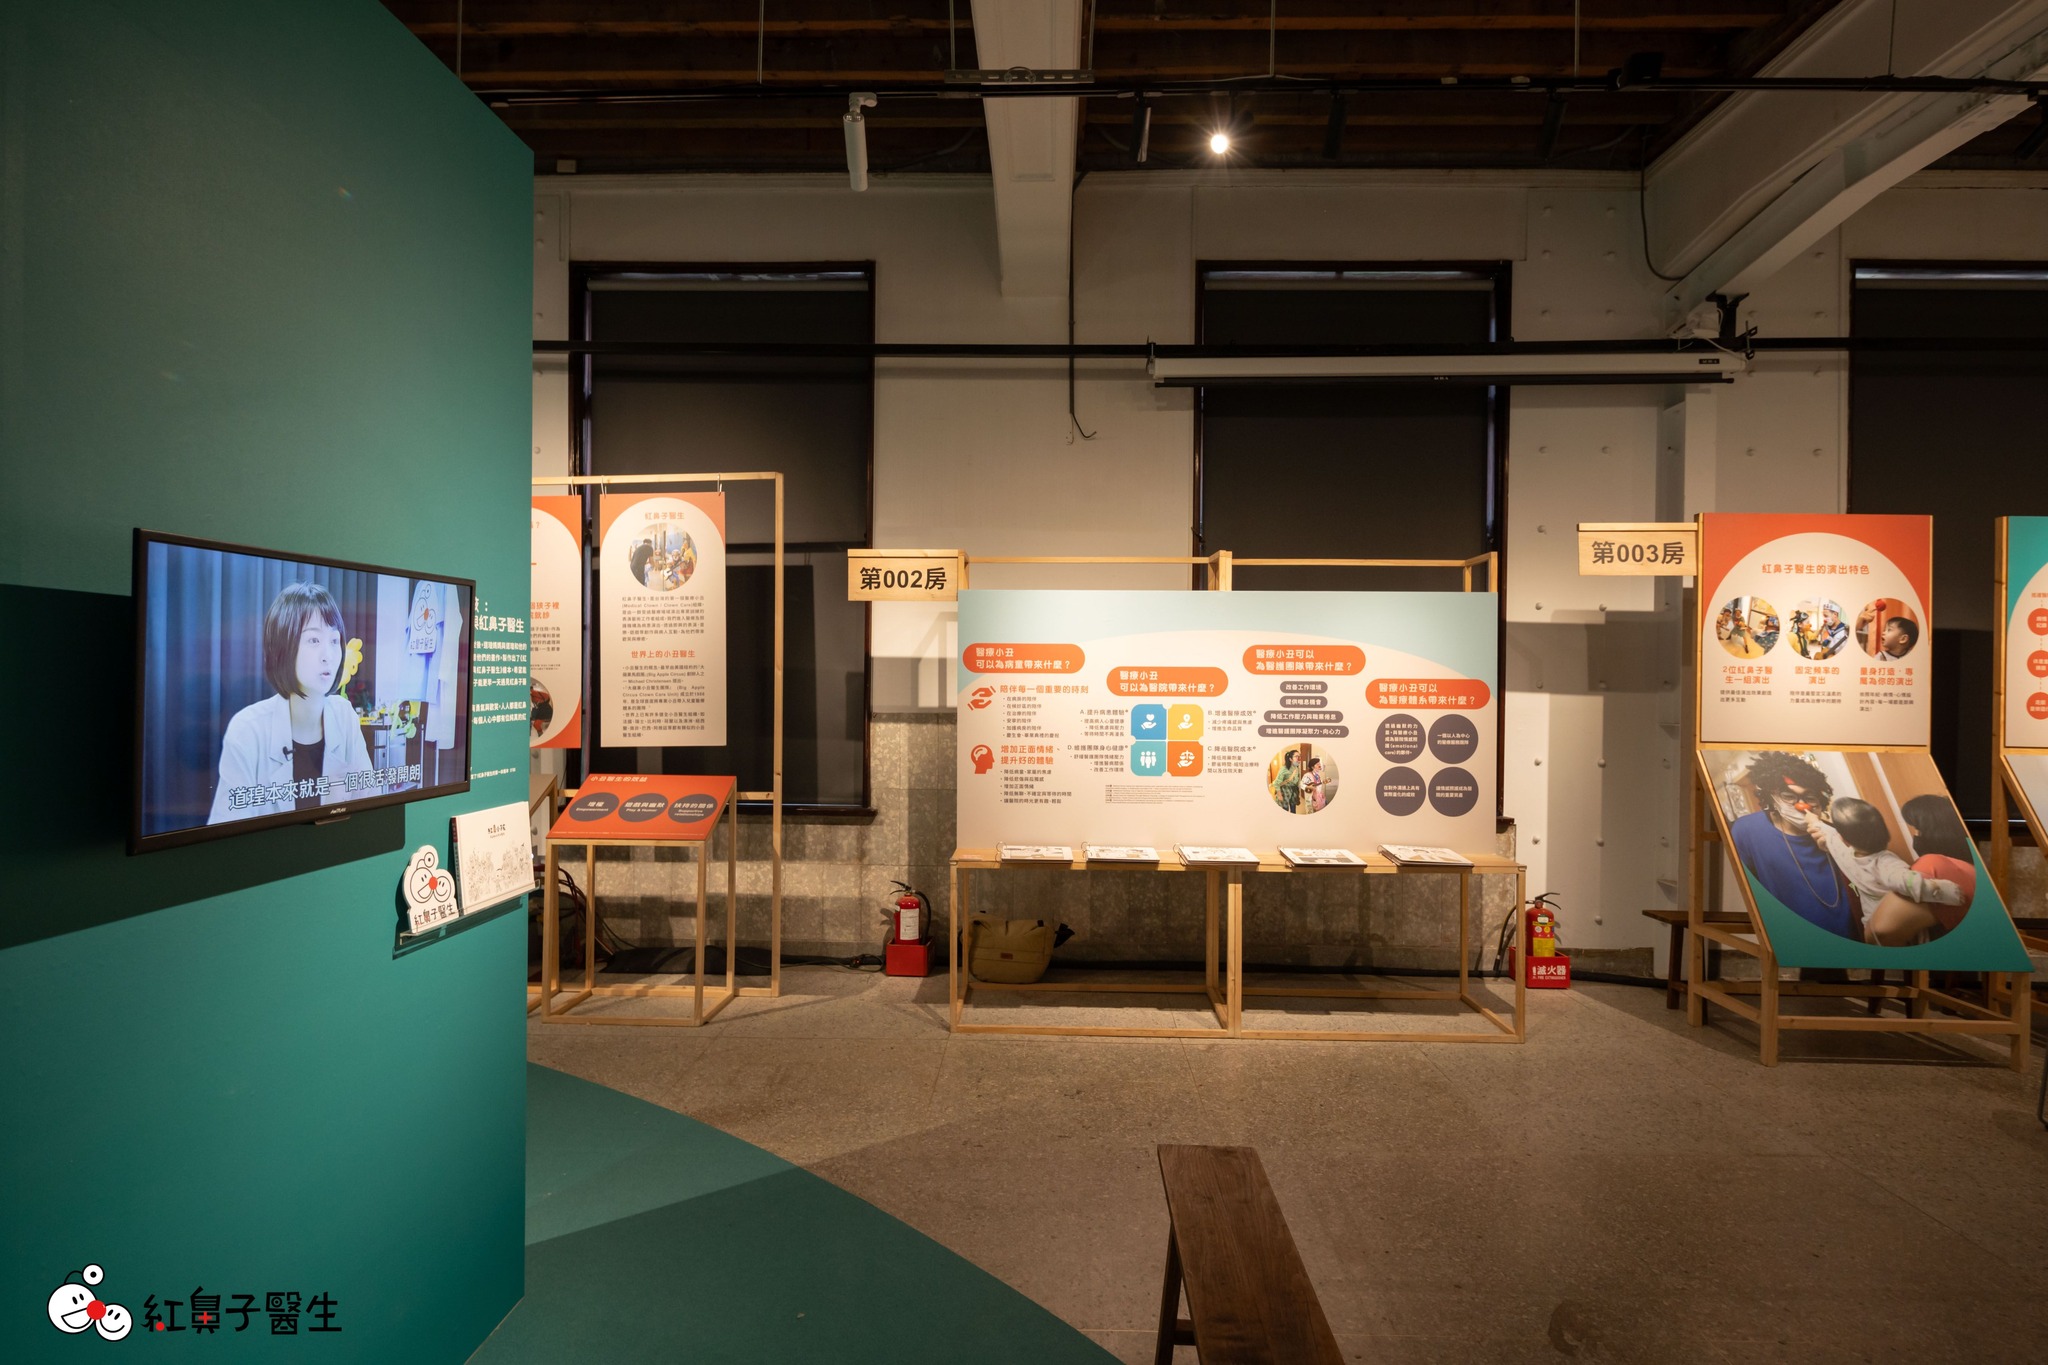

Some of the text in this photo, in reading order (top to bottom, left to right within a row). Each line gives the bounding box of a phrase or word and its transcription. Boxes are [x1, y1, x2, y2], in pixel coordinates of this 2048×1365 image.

[645, 512, 684, 520] 紅鼻子醫生
[1591, 540, 1685, 565] 第003房
[1762, 563, 1870, 575] 紅鼻子醫生的演出特色
[860, 567, 947, 590] 第002房
[631, 650, 695, 658] 世界上的小丑醫生
[976, 647, 1014, 657] 醫療小丑
[1256, 649, 1314, 659] 醫療小丑可以
[976, 660, 1070, 670] 可以為病童帶來什麼？
[1256, 661, 1352, 671] 為醫護團隊帶來什麼？
[1120, 670, 1158, 680] 醫療小丑
[1722, 666, 1773, 675] 2位紅鼻子醫
[1795, 666, 1840, 675] 固定頻率的
[1725, 676, 1770, 684] 生一組演出
[1809, 676, 1826, 684] 演出
[1860, 677, 1913, 686] 屬為你的演出
[1000, 685, 1088, 694] 陪伴每一個重要的時刻
[1120, 682, 1215, 693] 可以為醫院帶來什麼？
[1378, 683, 1437, 693] 醫療小丑可以
[1378, 695, 1475, 705] 為醫療體系帶來什麼？
[1000, 756, 1054, 765] 提升好的體驗
[414, 904, 456, 926] 紅鼻子醫生
[1537, 965, 1566, 975] 滅火器
